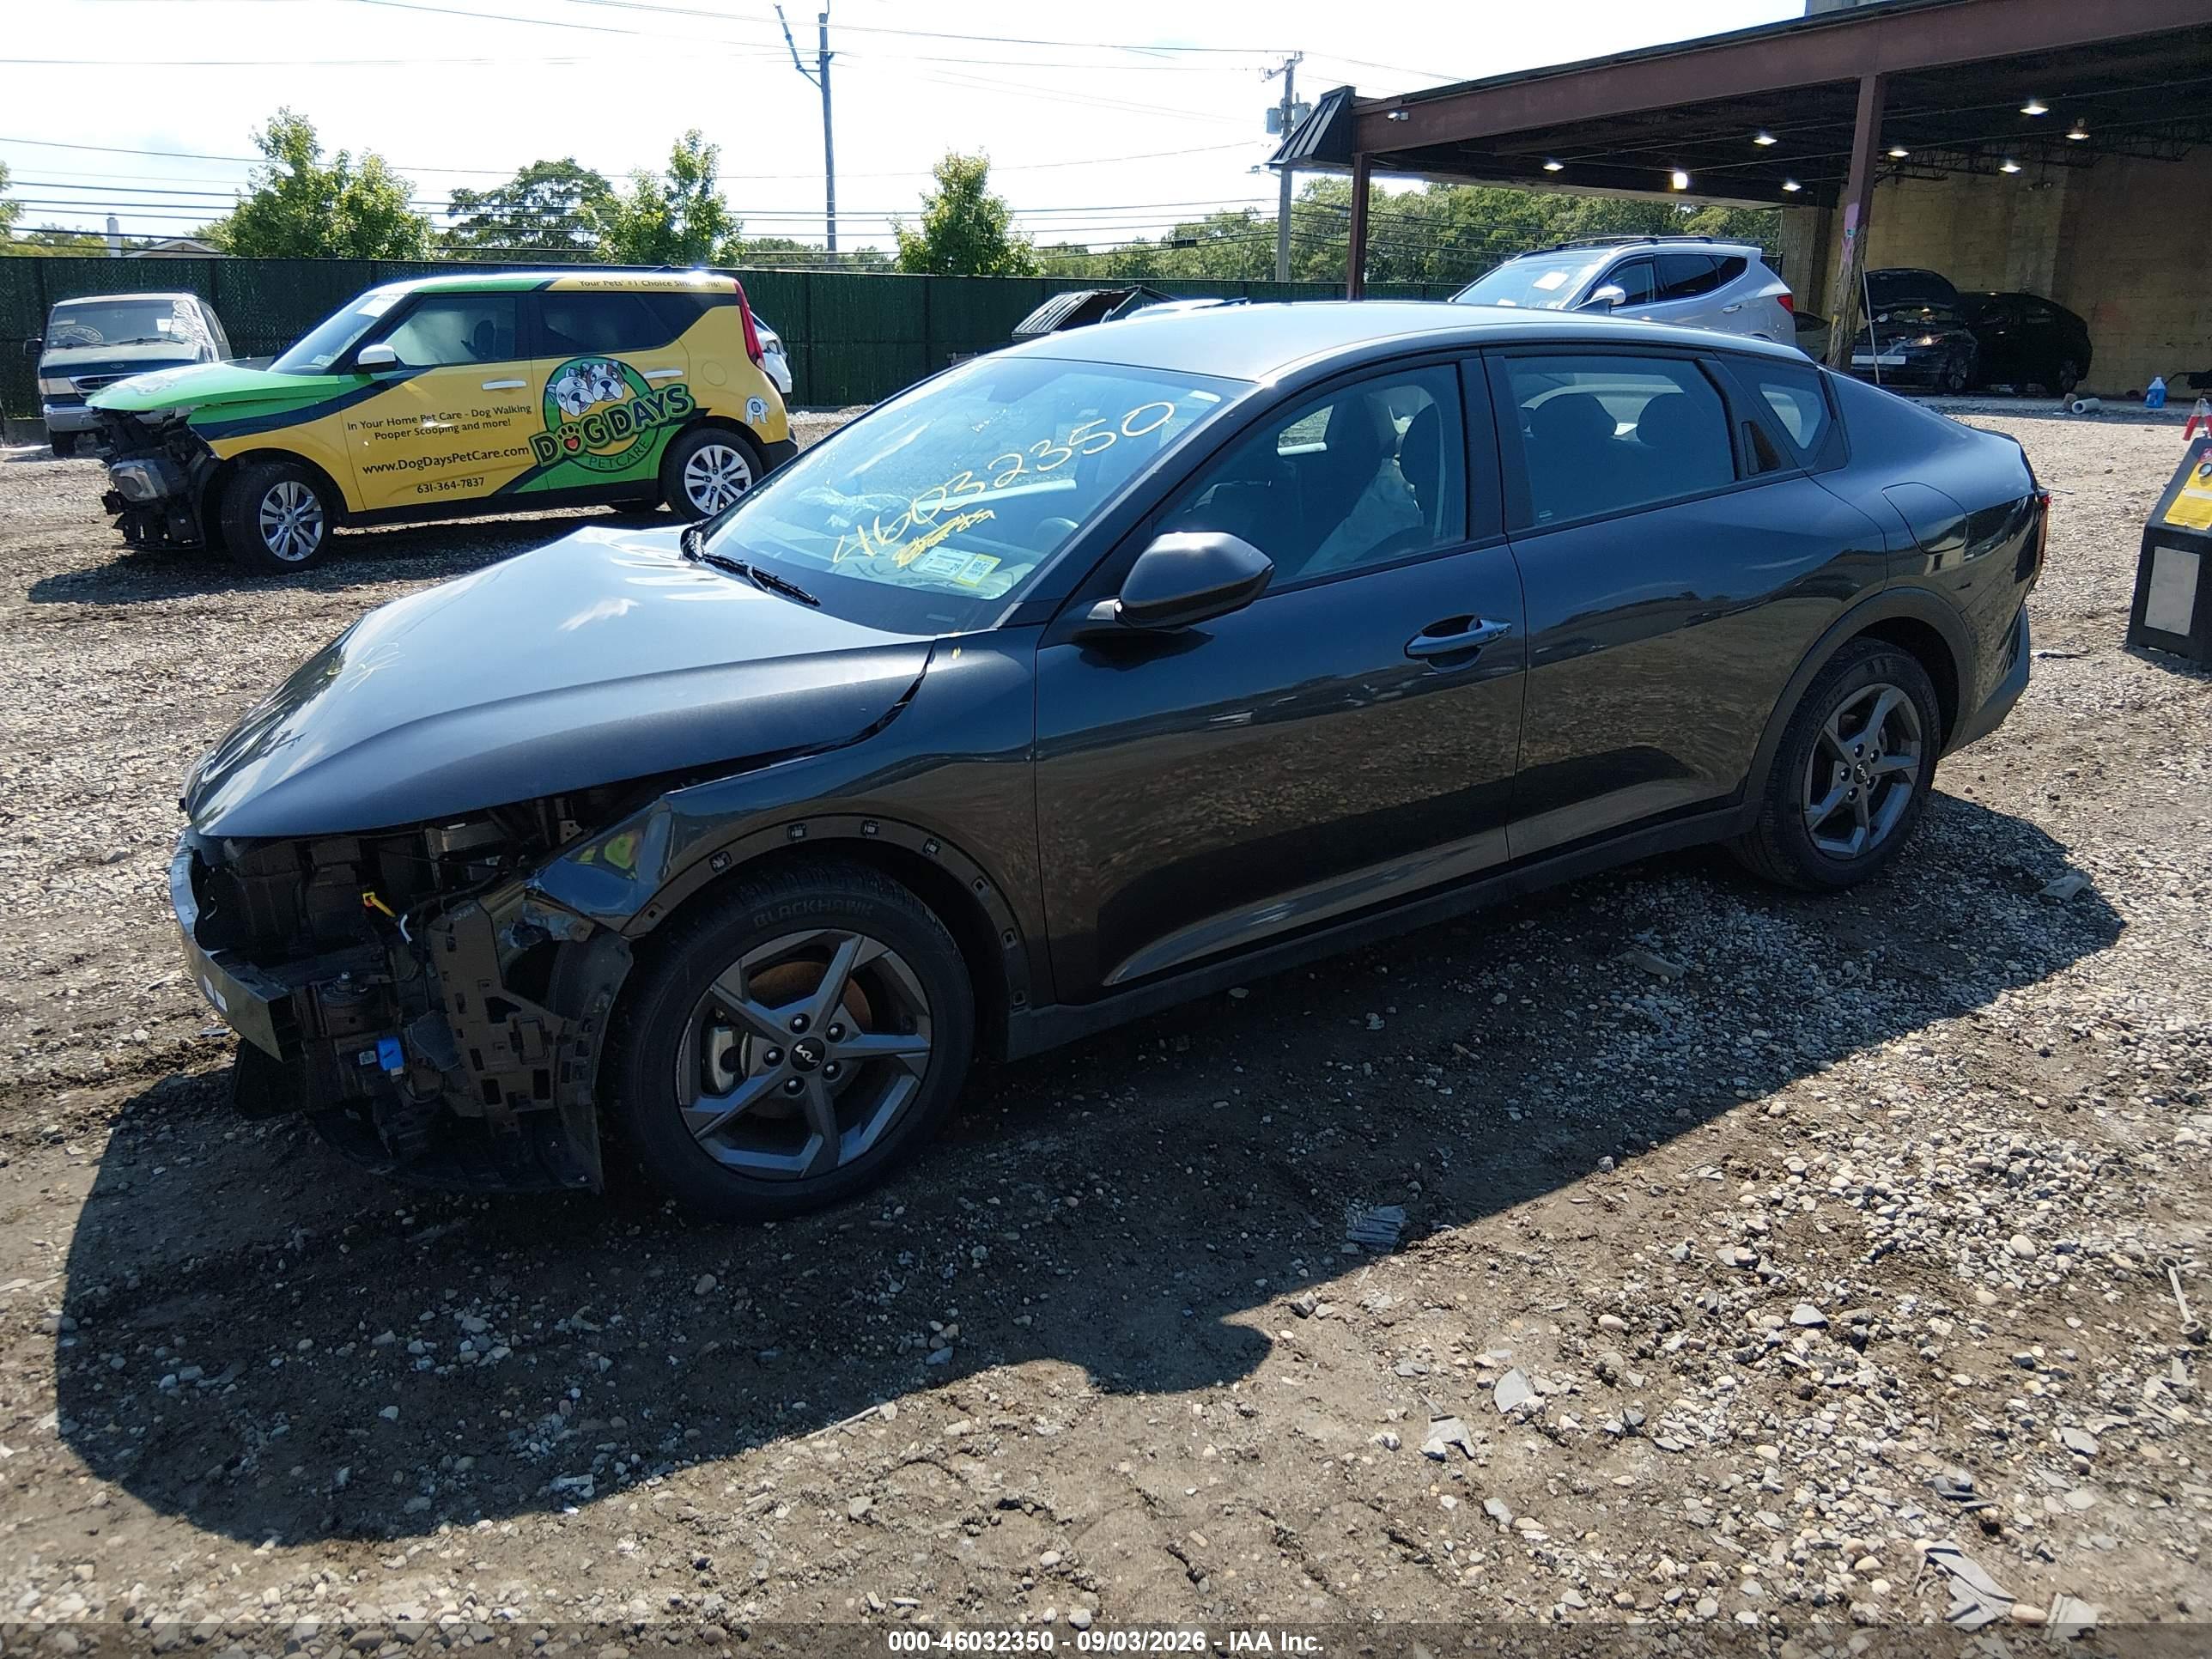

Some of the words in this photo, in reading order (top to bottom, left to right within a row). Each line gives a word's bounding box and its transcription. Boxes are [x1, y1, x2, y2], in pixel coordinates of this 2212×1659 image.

[347, 422, 358, 430] In
[360, 419, 384, 428] Your
[386, 416, 418, 428] Home
[420, 413, 436, 423] Pet
[439, 411, 463, 421] Care
[471, 408, 492, 419] Dog
[492, 404, 532, 416] Walking
[606, 388, 690, 439] DAYS
[374, 429, 412, 441] Pooper
[414, 422, 460, 436] Scooping
[461, 419, 481, 431] and
[482, 417, 512, 428] more!
[362, 447, 530, 475] www.DogDaysPetCare.com
[588, 439, 650, 470] PETCARE
[416, 477, 485, 495] 631-364-7837
[832, 401, 1176, 564] 46032350
